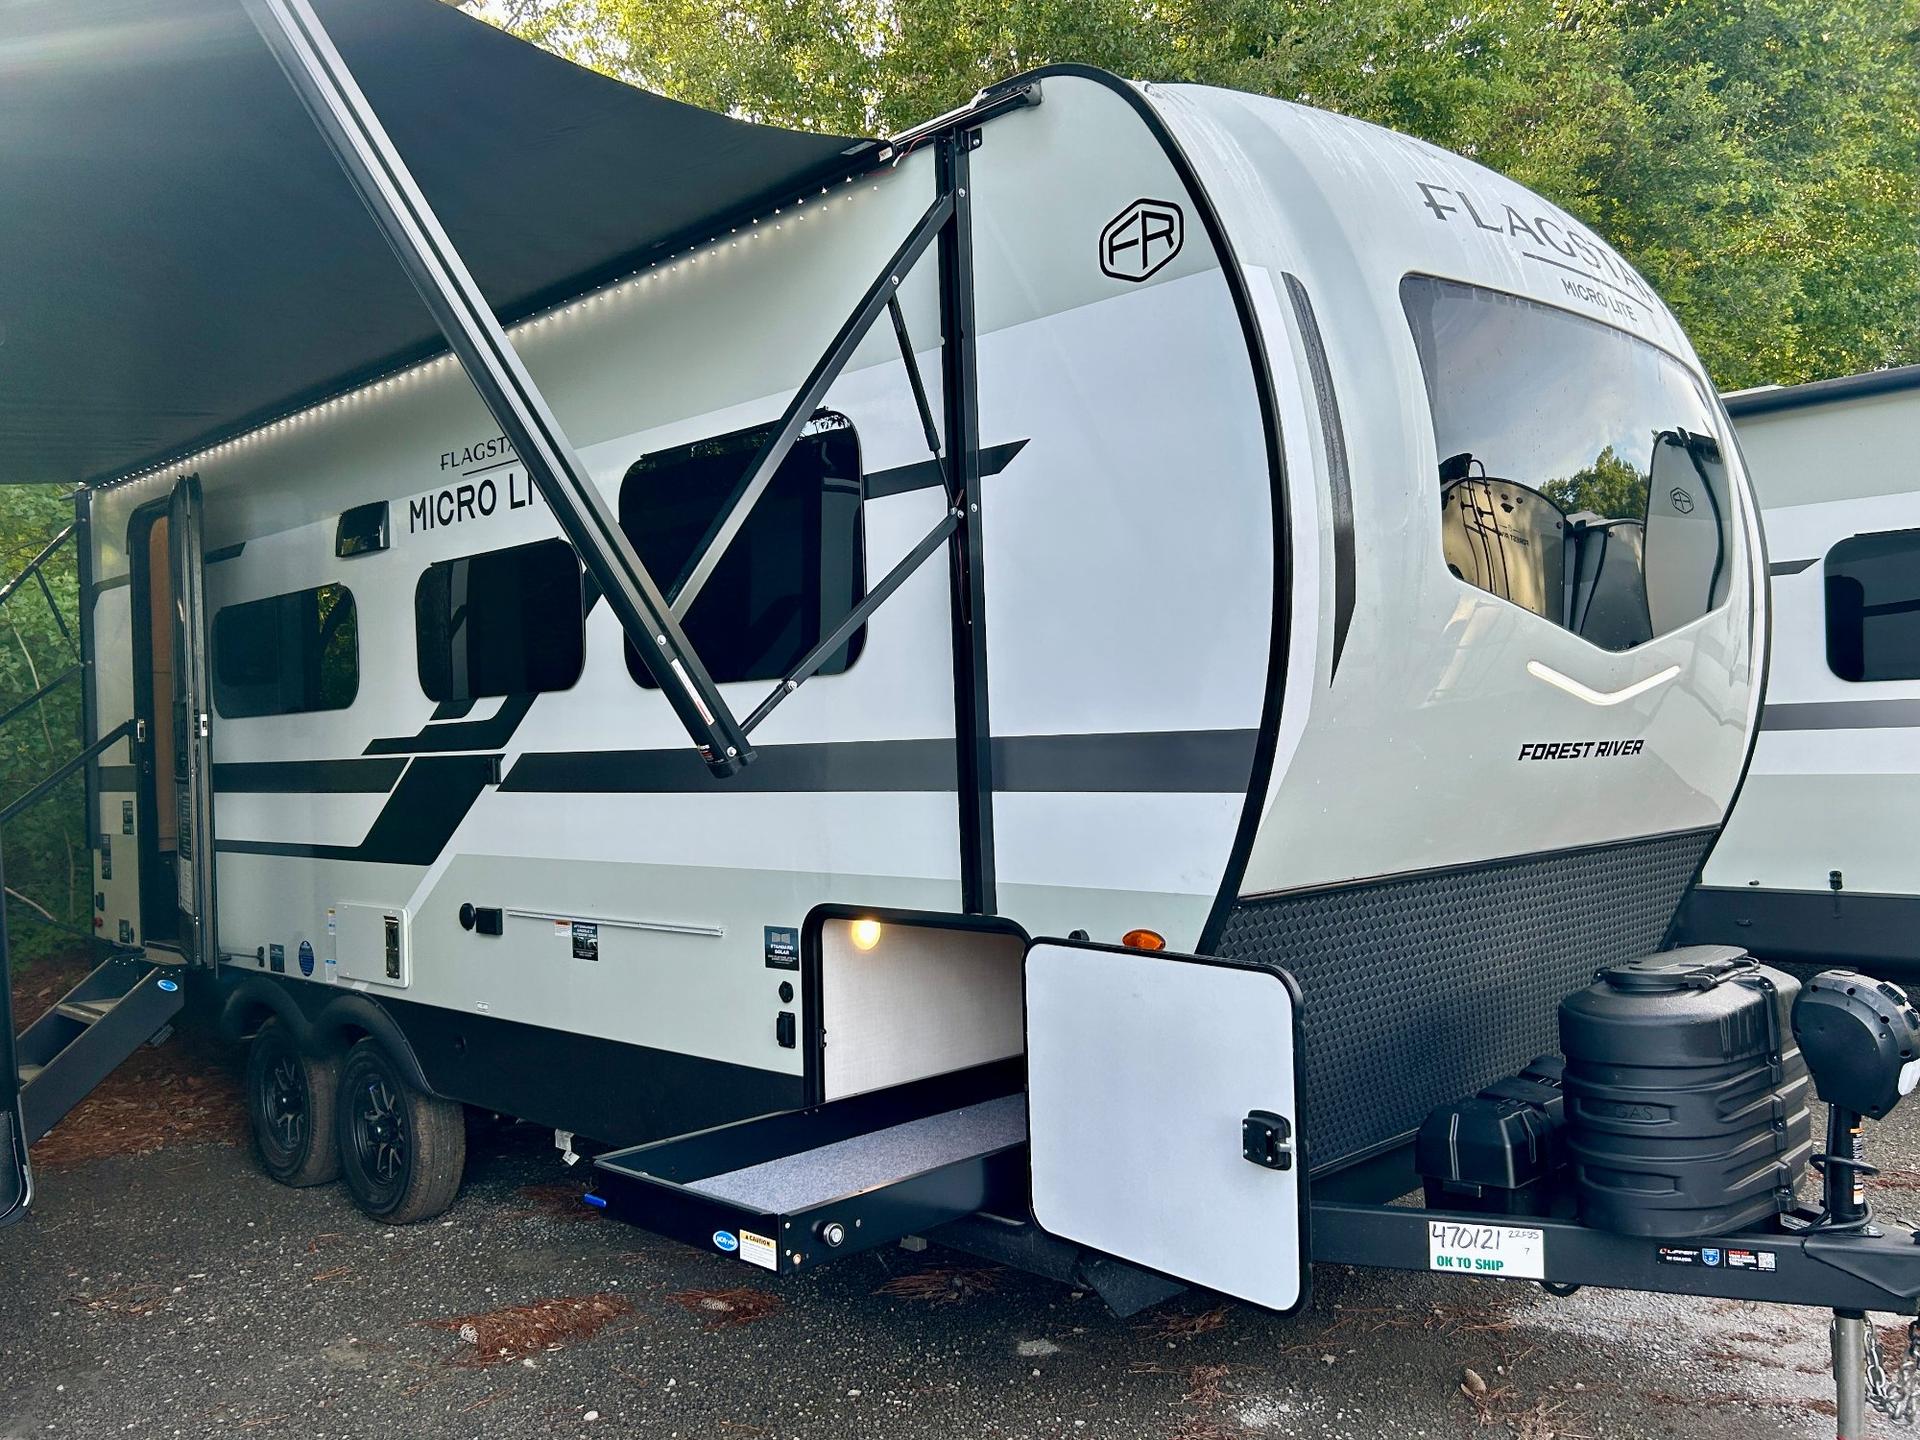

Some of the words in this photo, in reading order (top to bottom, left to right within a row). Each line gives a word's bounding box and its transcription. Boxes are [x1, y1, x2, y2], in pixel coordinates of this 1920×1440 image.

[1560, 278, 1608, 309] MICRO
[1607, 295, 1638, 322] LITE
[409, 479, 497, 533] MICRO
[509, 472, 536, 510] LI
[1518, 741, 1595, 760] FOREST
[1595, 740, 1645, 757] RIVER
[749, 1235, 770, 1246] CAUTION
[1433, 1223, 1500, 1250] 470121
[1437, 1256, 1453, 1267] OK
[1456, 1257, 1471, 1268] TO
[1475, 1258, 1504, 1271] SHIP
